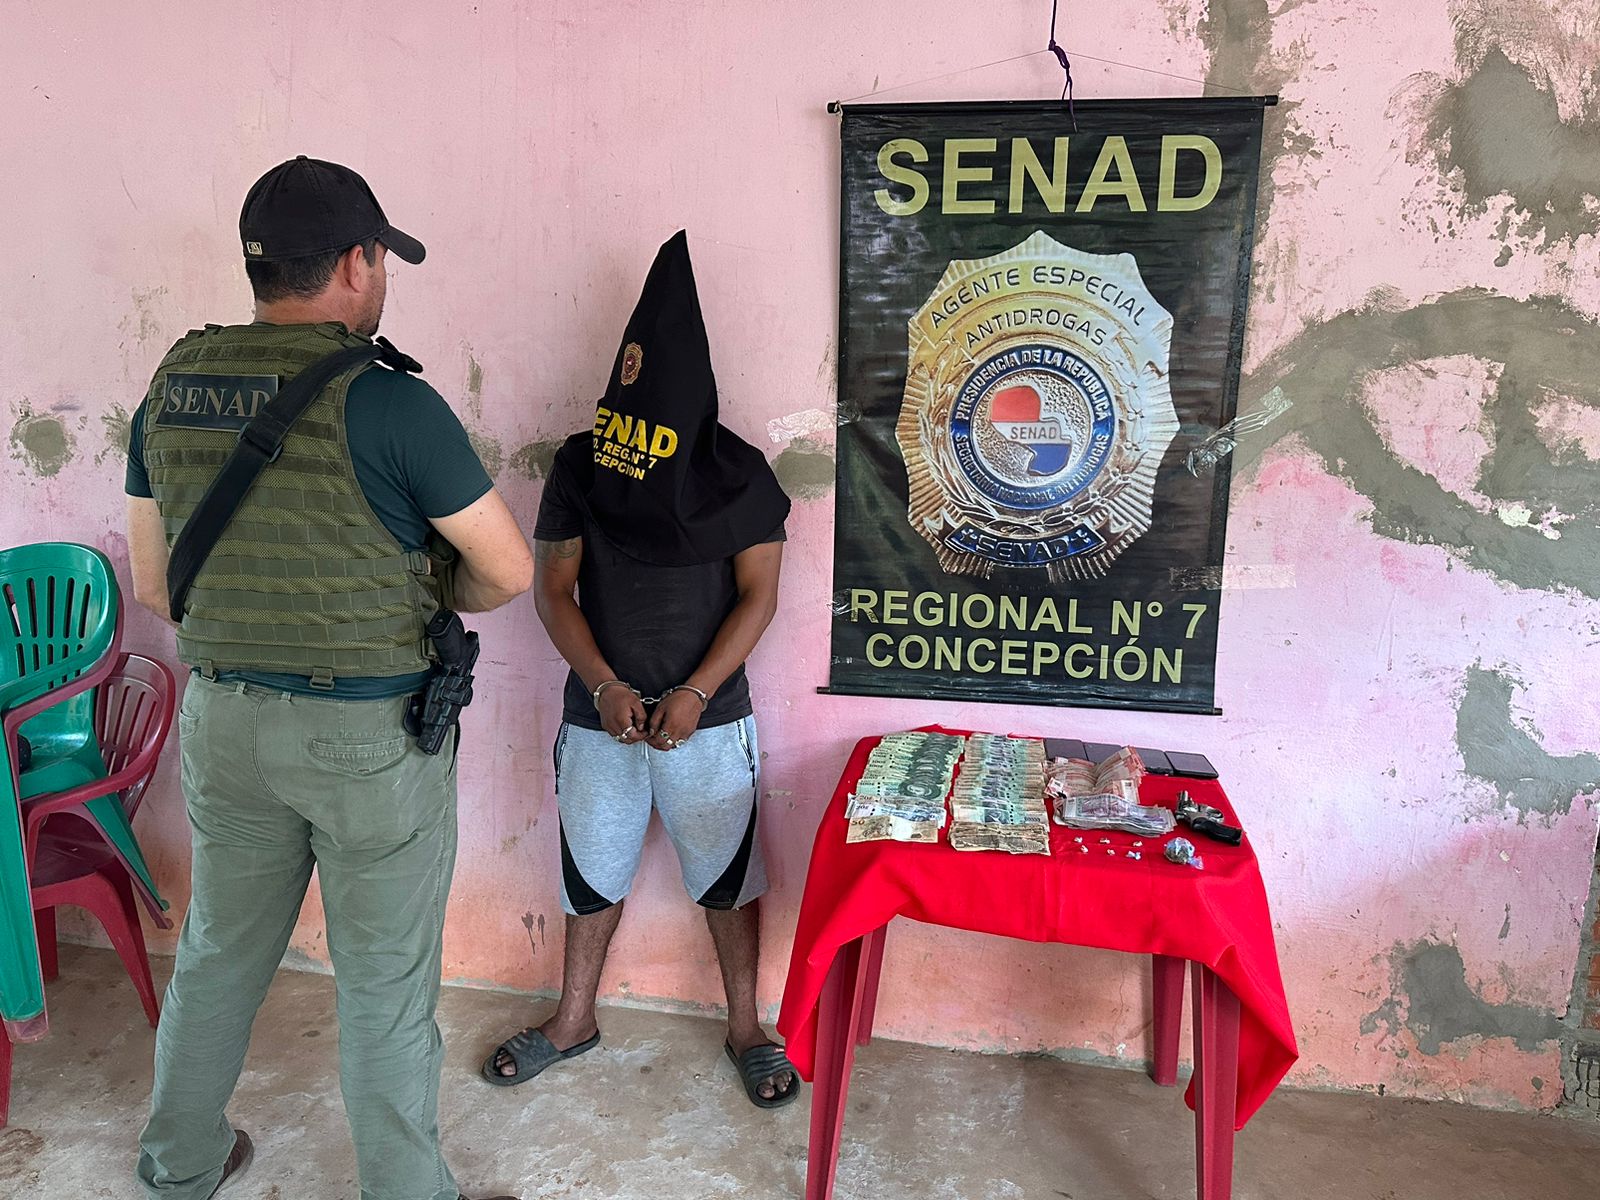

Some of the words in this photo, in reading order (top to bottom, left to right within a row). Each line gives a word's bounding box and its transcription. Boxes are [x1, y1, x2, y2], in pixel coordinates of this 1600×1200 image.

[873, 134, 1223, 217] SENAD
[930, 268, 1020, 329] AGENTE
[1033, 266, 1145, 326] ESPECIAL
[966, 308, 1107, 349] ANTIDROGAS
[164, 386, 271, 418] SENAD
[955, 351, 1020, 421] PRESIDENCIA
[1021, 349, 1042, 364] DE
[1042, 349, 1064, 367] LA
[1010, 426, 1058, 440] SENAD
[648, 457, 657, 469] 7
[850, 588, 1093, 635] REGIONAL
[1111, 600, 1164, 637] N°
[1182, 603, 1207, 639] 7
[866, 633, 1183, 684] CONCEPCIÓN
